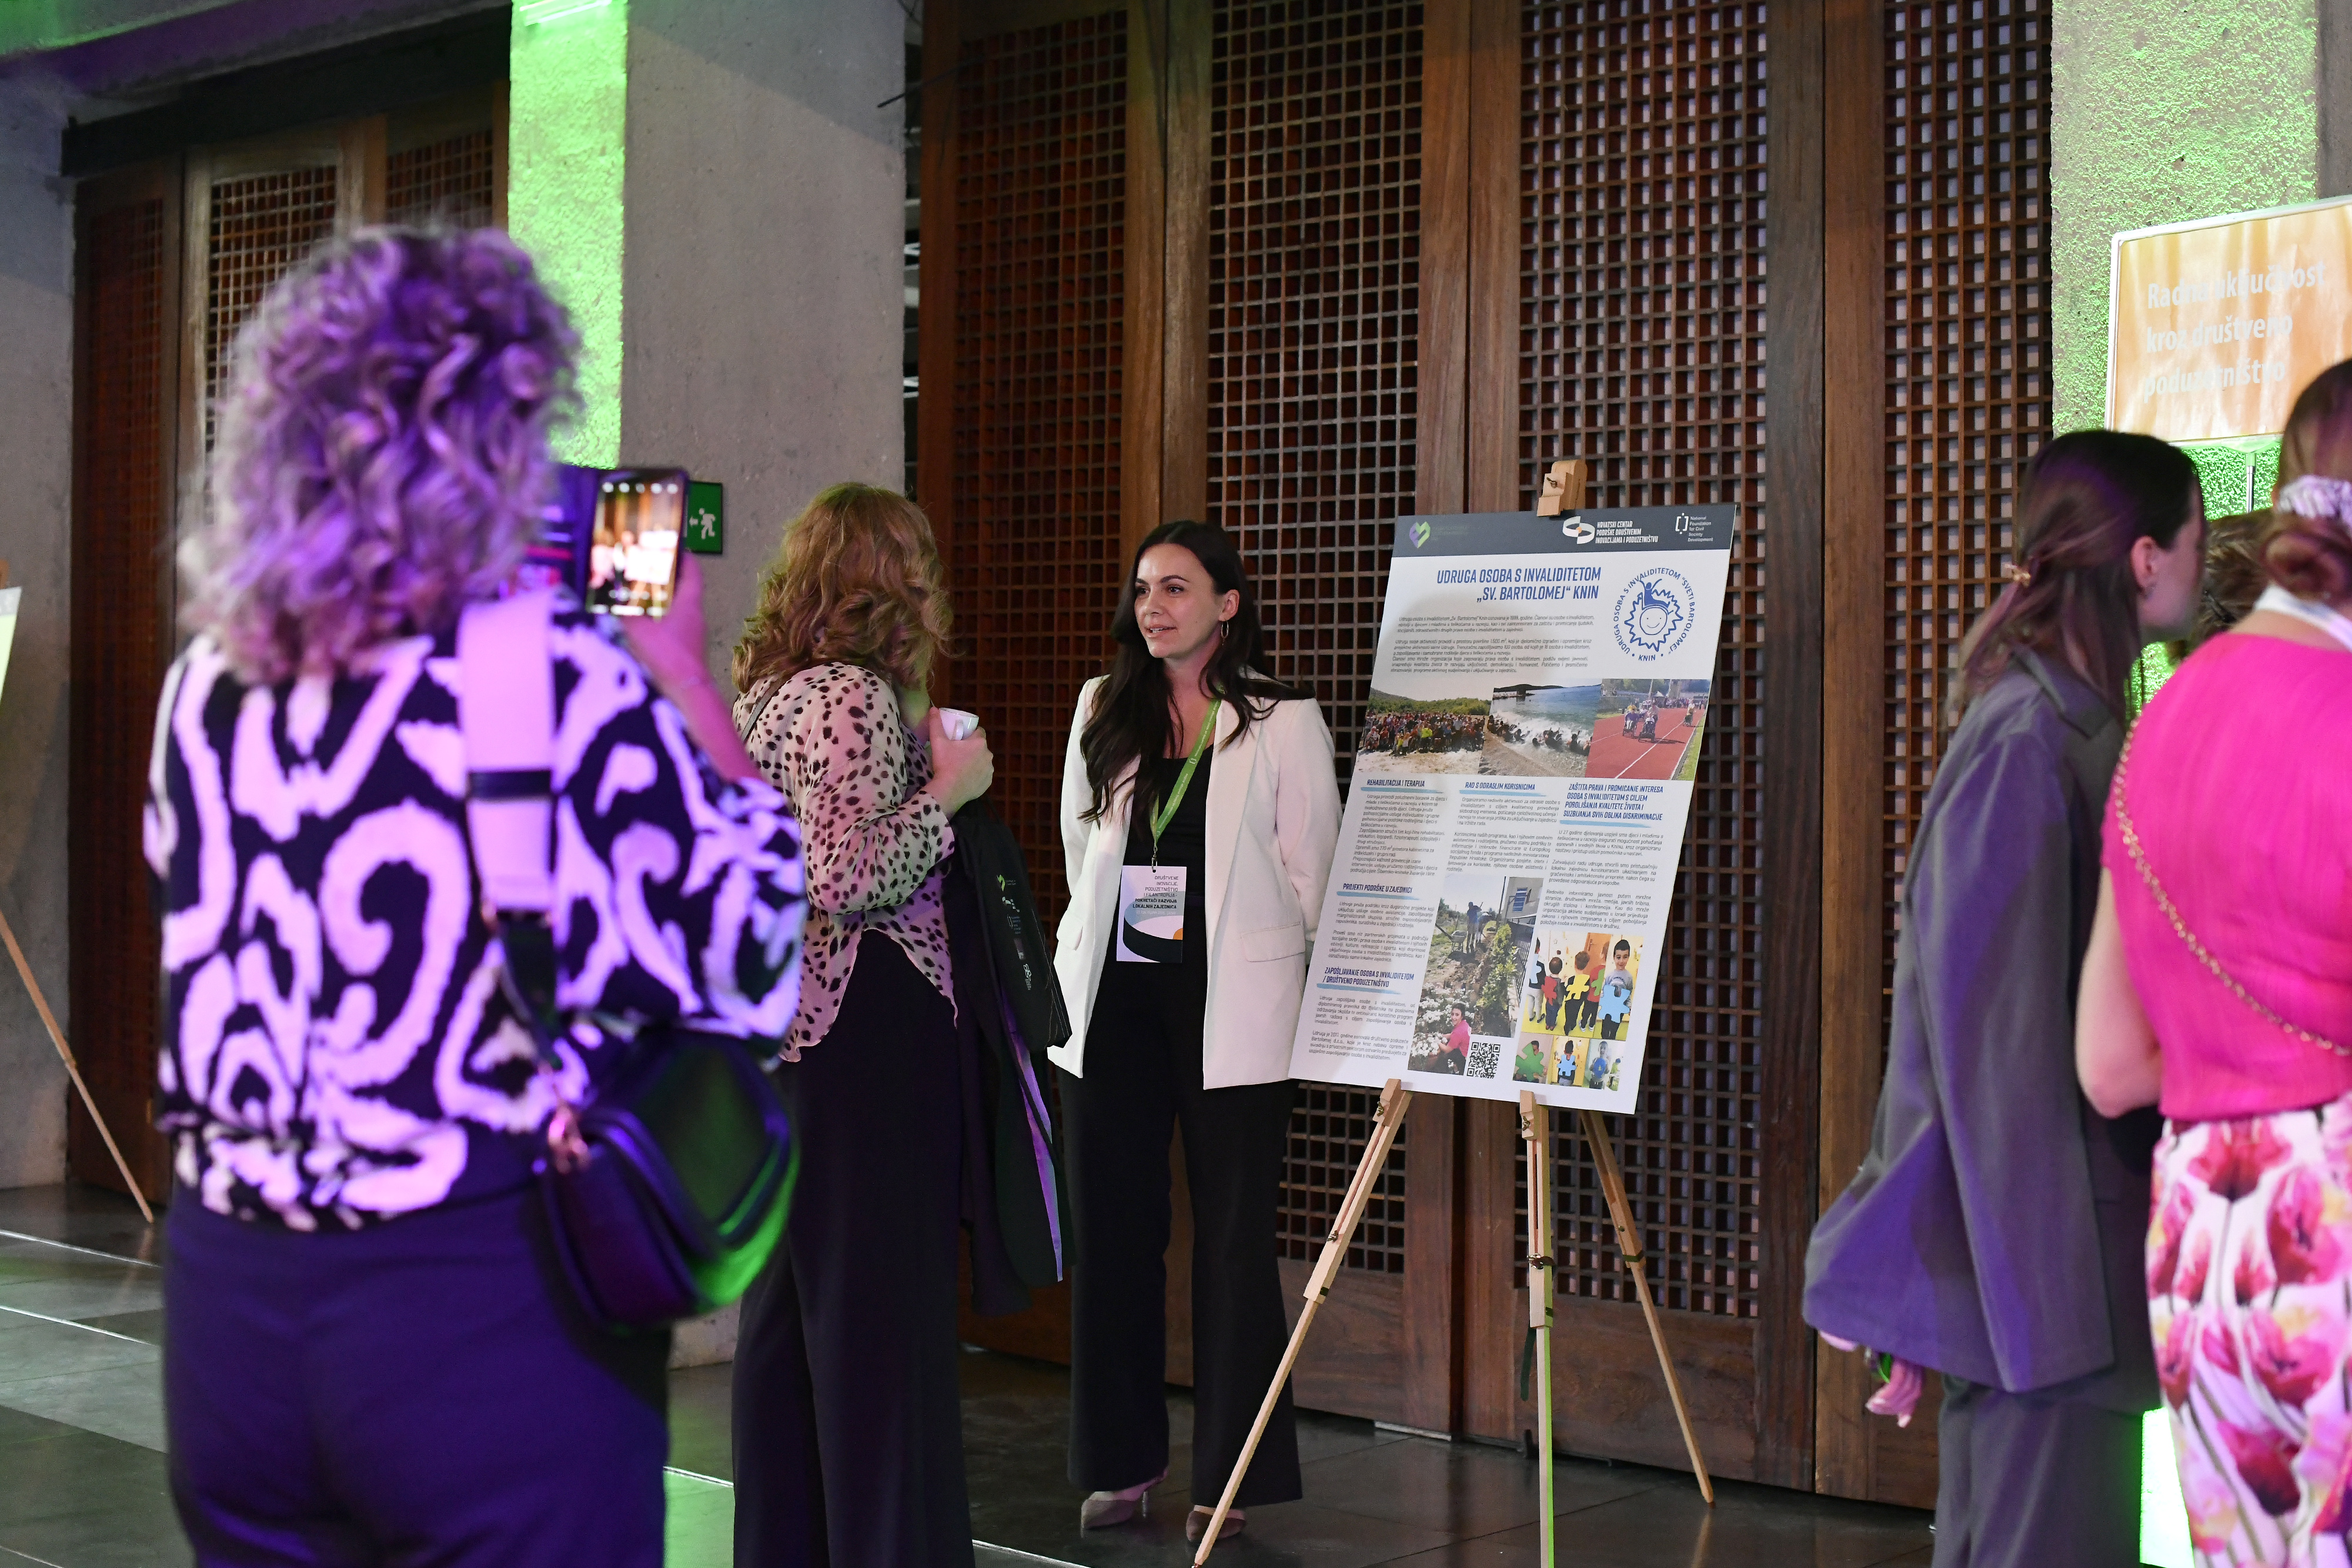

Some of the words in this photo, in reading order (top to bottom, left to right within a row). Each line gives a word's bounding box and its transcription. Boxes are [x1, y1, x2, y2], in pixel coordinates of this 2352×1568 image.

[2148, 279, 2209, 309] Radna
[2147, 326, 2187, 353] kroz
[2192, 315, 2293, 347] društveno
[2144, 358, 2285, 403] poduzetništvo
[1626, 534, 1658, 543] PODUZETNIŠTVU
[1437, 570, 1476, 583] UDRUGA
[1479, 569, 1512, 583] OSOBA
[1515, 569, 1521, 582] S
[1524, 567, 1601, 581] INVALIDITETOM
[1628, 568, 1681, 588] INVALIDITETOM
[1573, 586, 1599, 599] KNIN
[1613, 595, 1625, 621] OSOBA
[1614, 624, 1630, 654] UDRUGA
[1569, 783, 1588, 791] ZAŠTITA
[1624, 802, 1641, 810] ŽIVOTA
[1325, 967, 1359, 977] ZAPOŠLJAVANJE
[1380, 971, 1414, 980] INVALIDITETOM
[1327, 975, 1352, 984] DRUŠTVENO
[1353, 979, 1389, 987] PODUZETNIŠTVO
